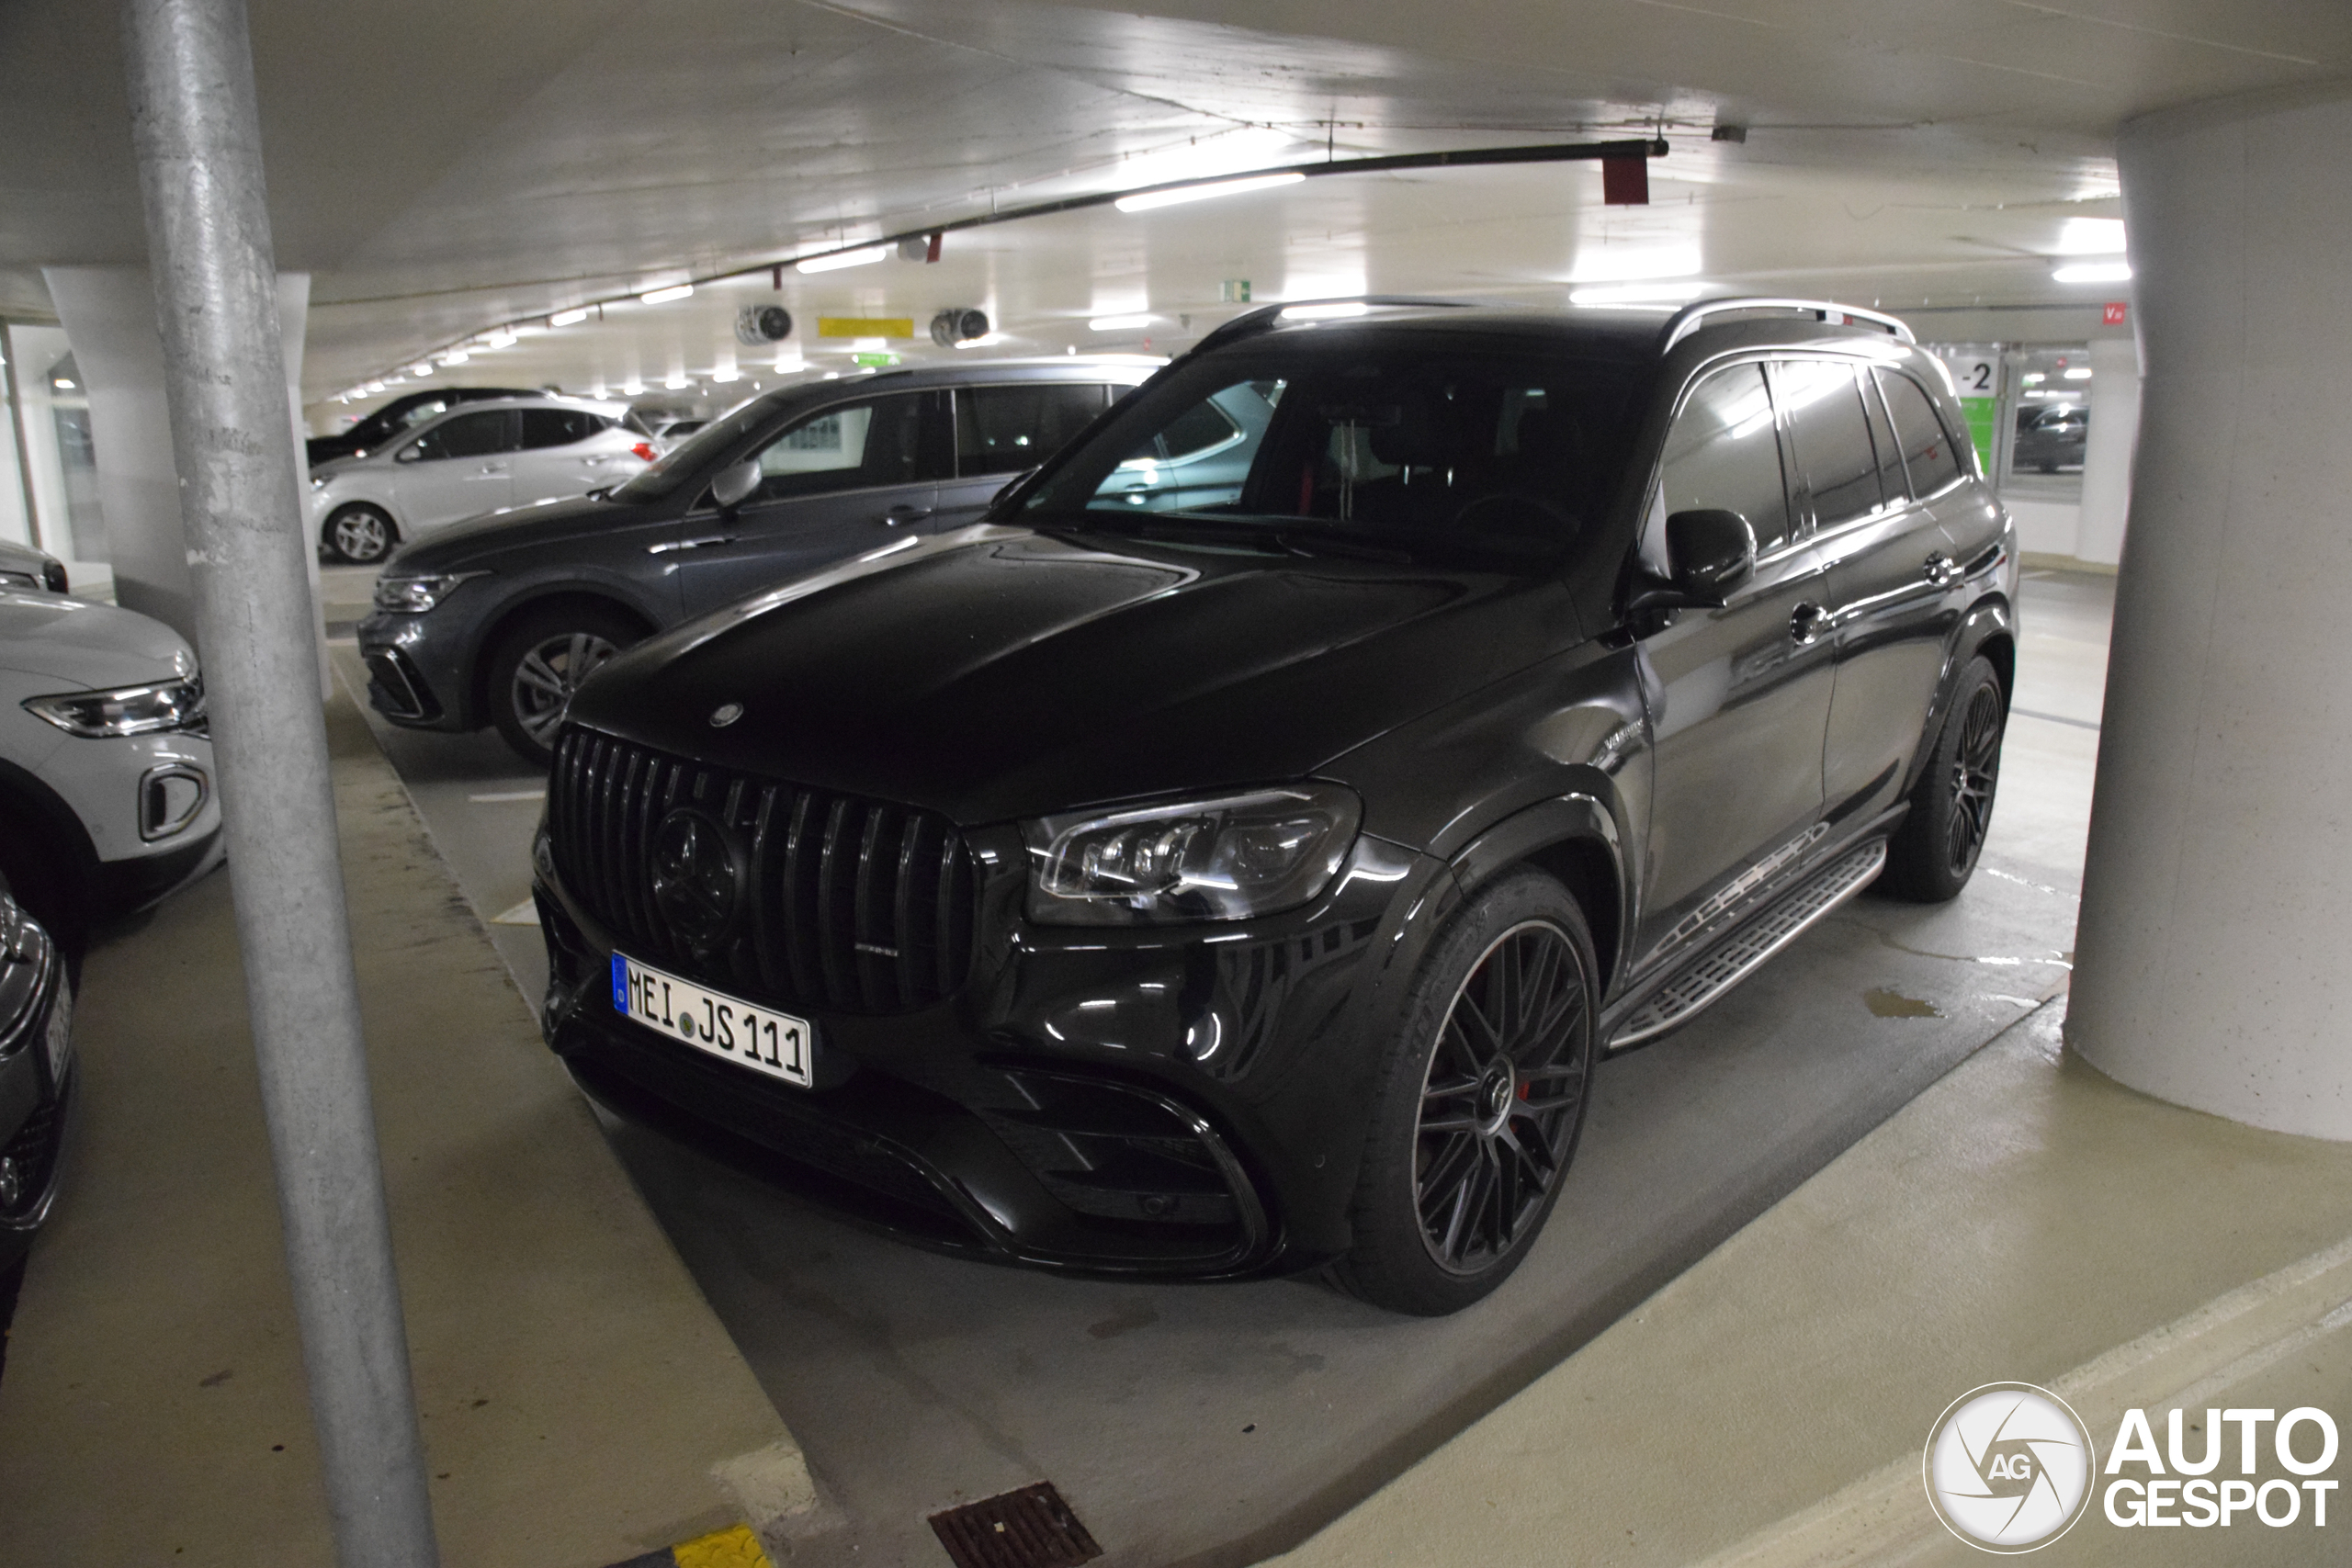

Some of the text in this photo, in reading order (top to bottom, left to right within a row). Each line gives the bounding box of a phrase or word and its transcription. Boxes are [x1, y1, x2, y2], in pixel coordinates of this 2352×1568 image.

[1962, 362, 1991, 390] -2
[628, 966, 805, 1076] MEI JS 111
